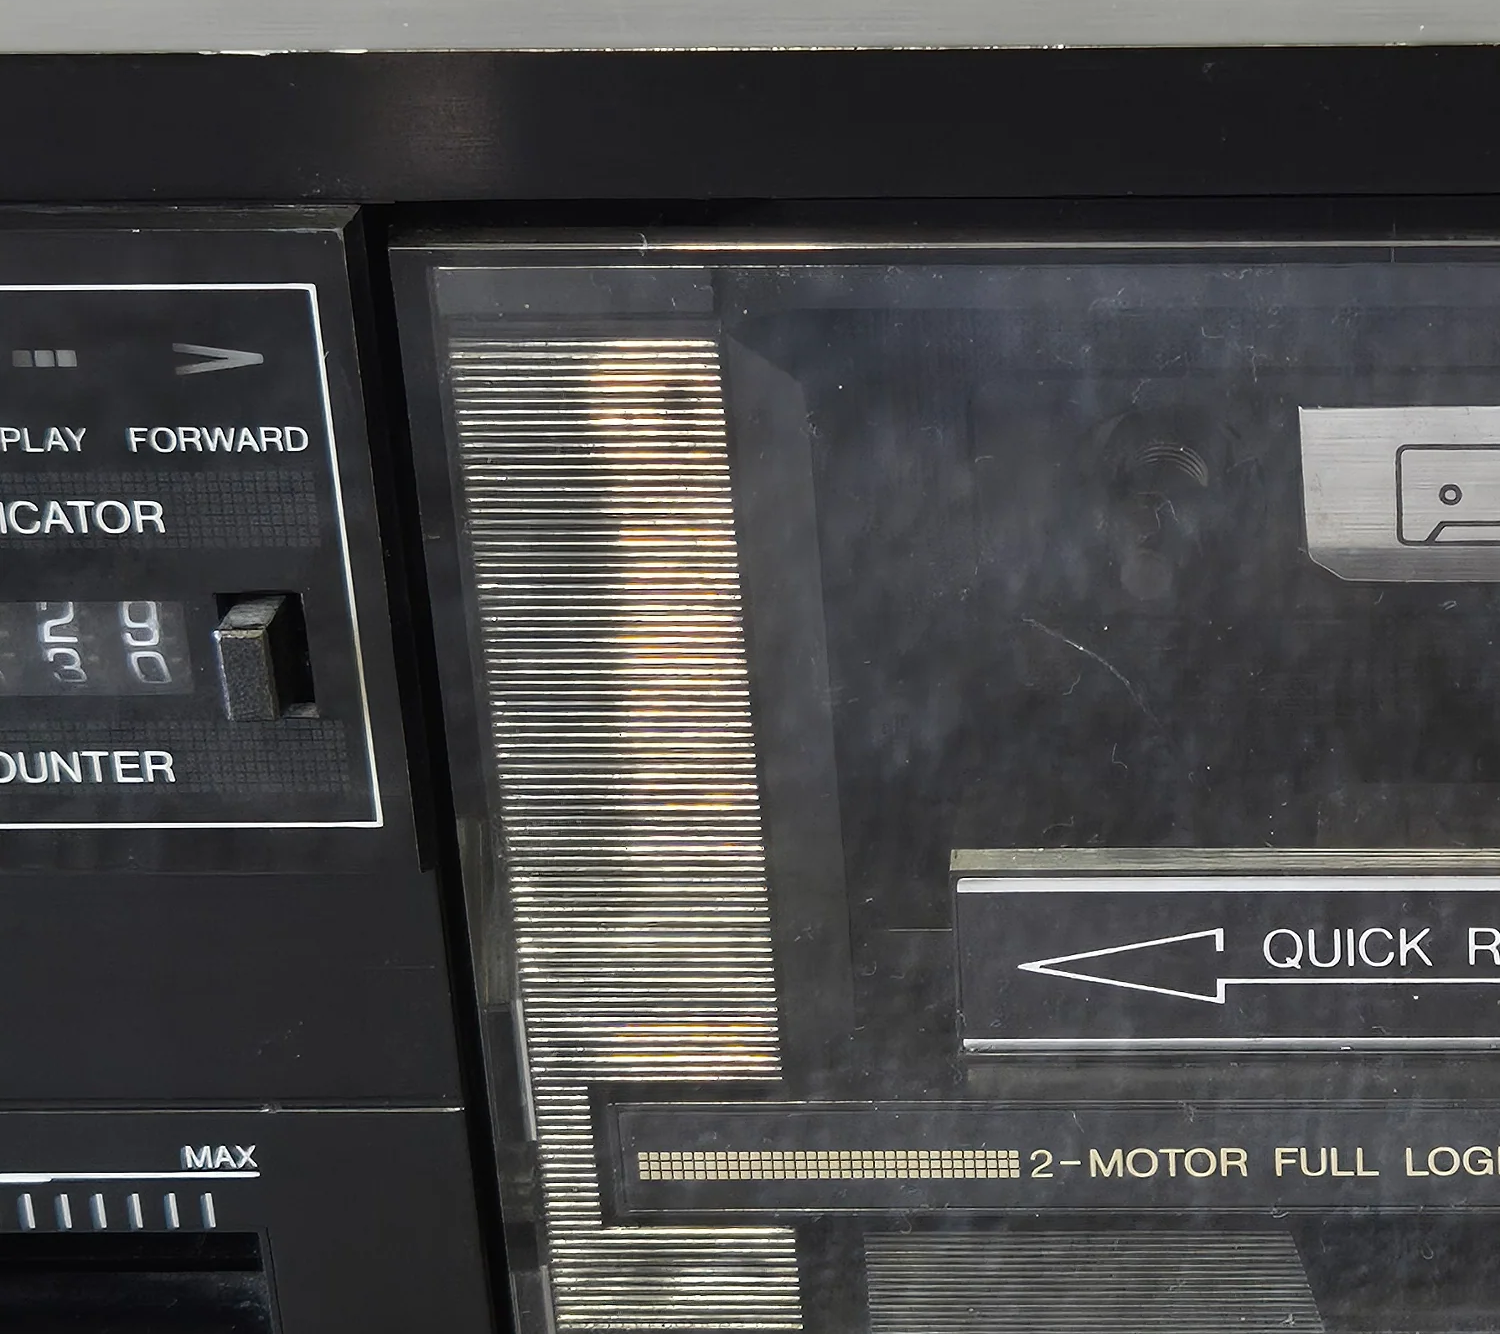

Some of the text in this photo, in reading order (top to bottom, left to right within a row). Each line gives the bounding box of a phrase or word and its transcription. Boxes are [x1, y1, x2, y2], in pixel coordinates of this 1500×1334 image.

[0, 426, 309, 453] PLAY FORWARD
[1262, 927, 1433, 970] QUICK
[181, 1144, 258, 1169] MAX
[1029, 1147, 1248, 1178] 2-MOTOR
[1274, 1147, 1380, 1177] FULL
